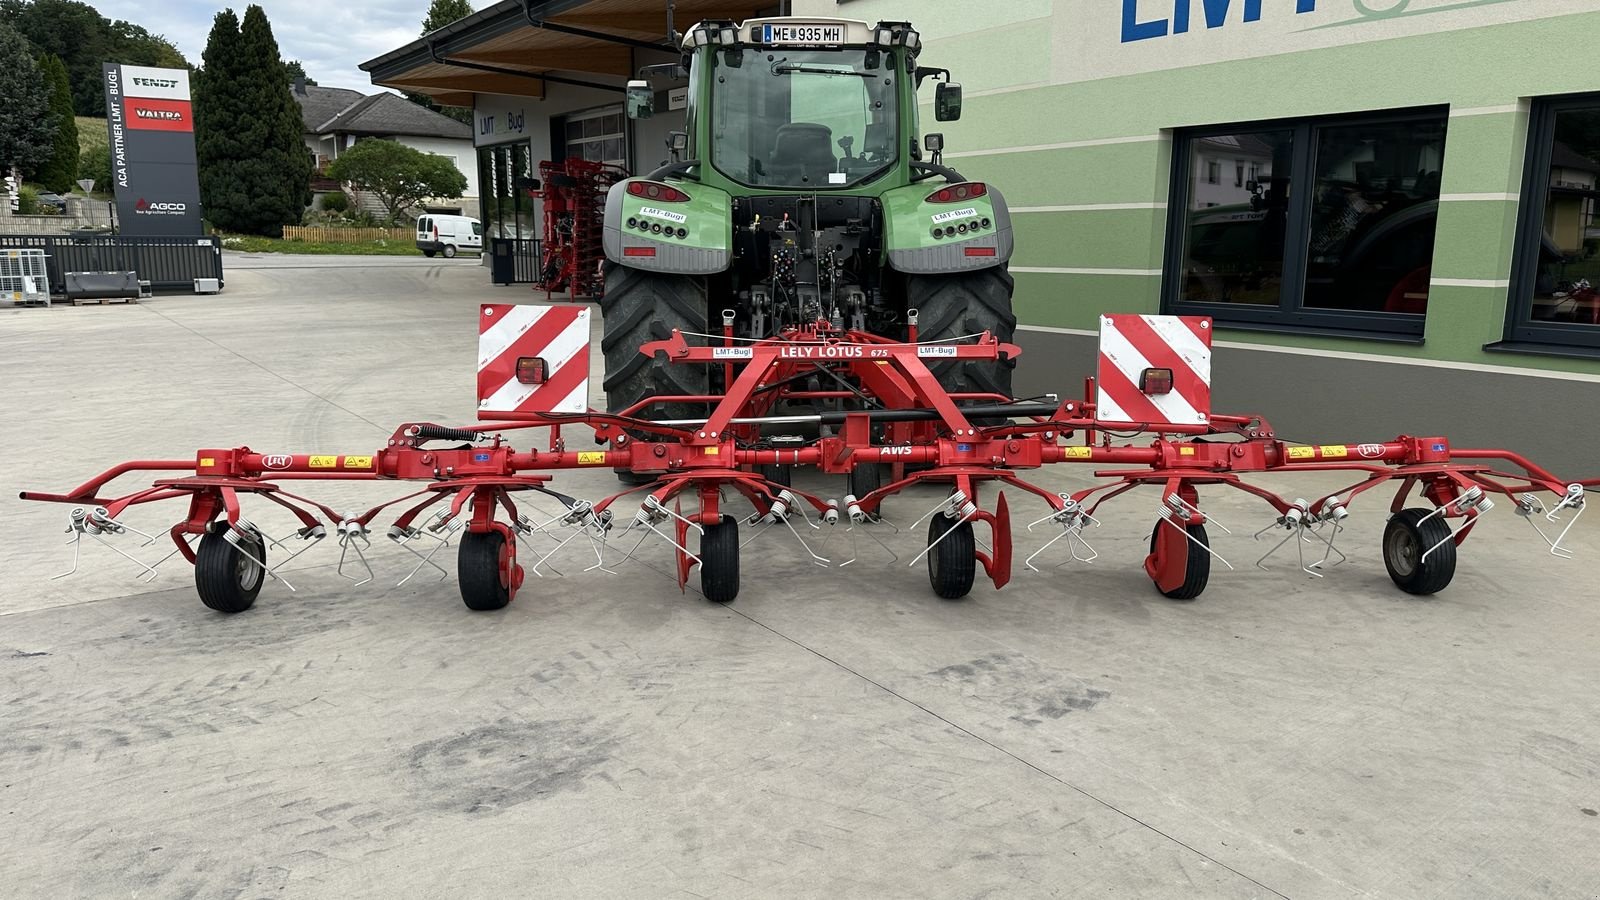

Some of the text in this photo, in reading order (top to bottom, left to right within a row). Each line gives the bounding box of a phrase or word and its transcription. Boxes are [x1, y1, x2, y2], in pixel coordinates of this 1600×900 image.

[773, 27, 840, 41] ME 935 MH
[108, 69, 119, 95] BUGL
[133, 77, 179, 89] FENDT
[111, 102, 121, 122] LMT
[135, 108, 184, 122] VALTRA
[480, 107, 525, 135] LMT Bugl
[113, 123, 126, 167] PARTNER
[118, 168, 128, 188] ACA
[150, 203, 186, 211] AGCO
[643, 207, 684, 221] LMT-Bugl
[934, 208, 974, 221] LMT-Bugl
[781, 346, 888, 358] LELY LOTUS 675
[880, 446, 912, 455] AWS
[267, 455, 287, 467] LELY
